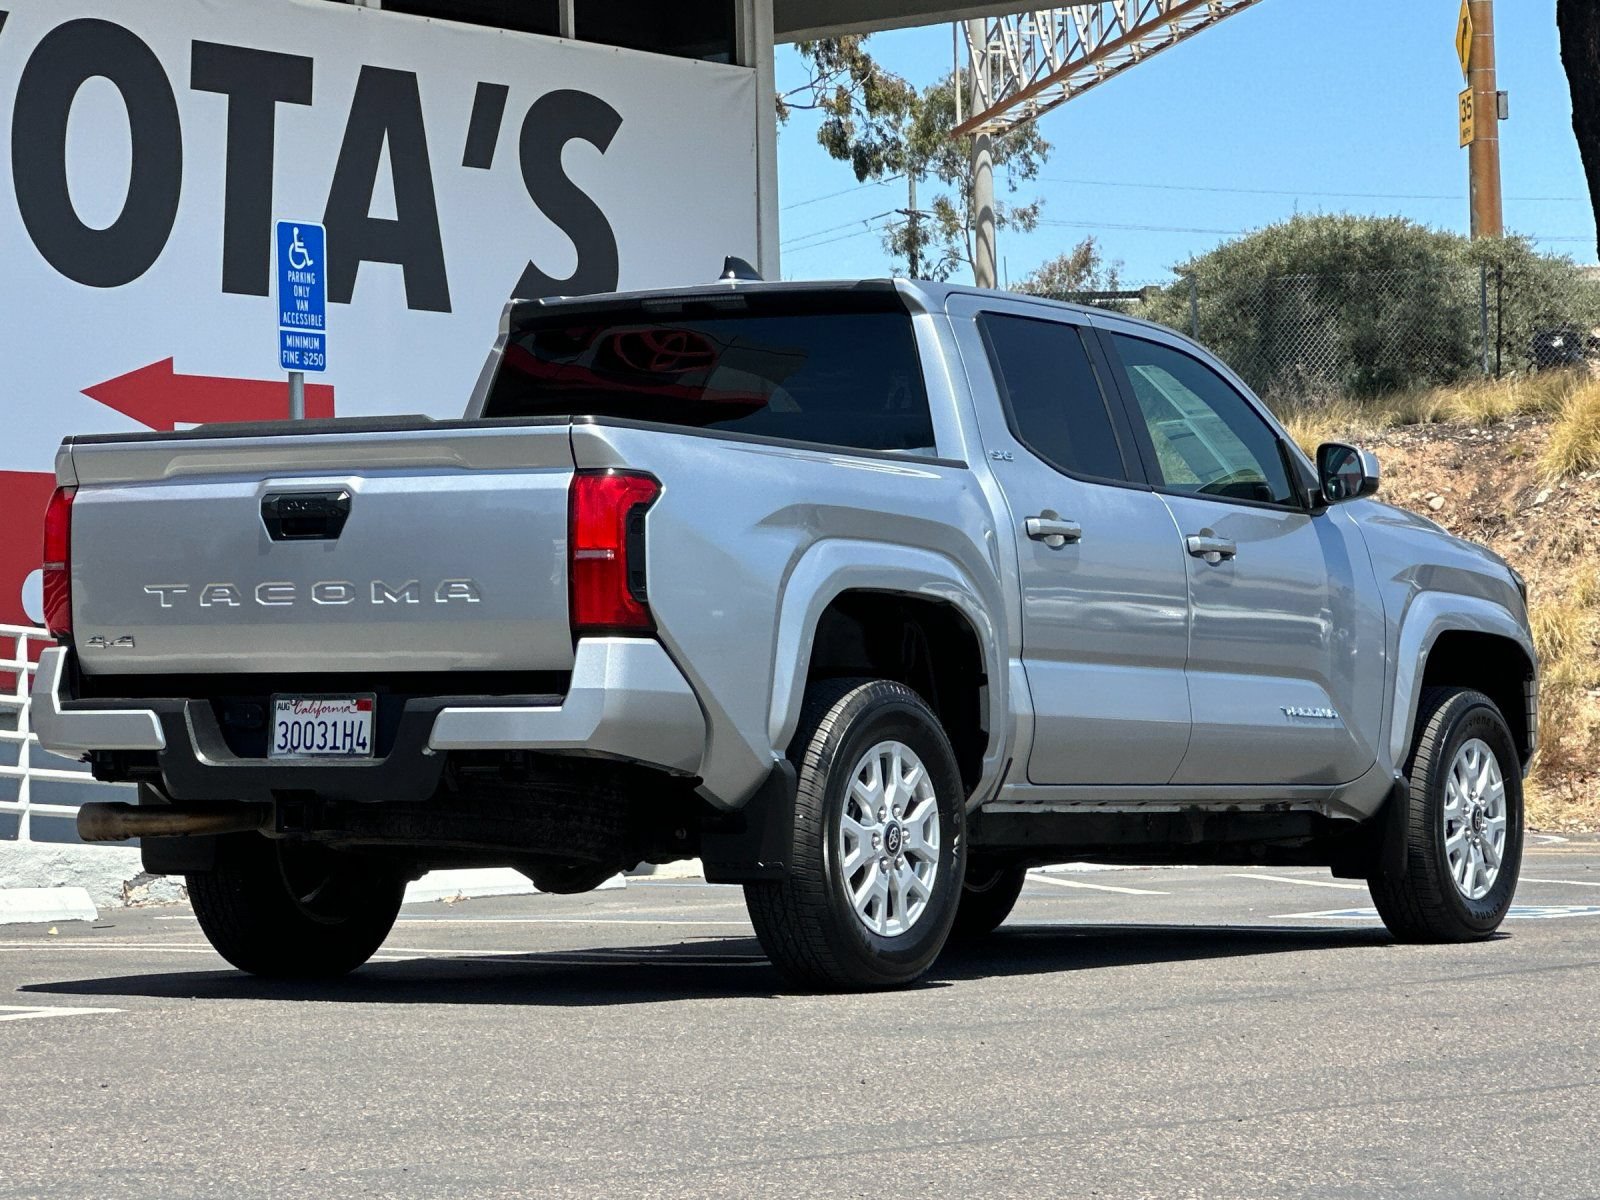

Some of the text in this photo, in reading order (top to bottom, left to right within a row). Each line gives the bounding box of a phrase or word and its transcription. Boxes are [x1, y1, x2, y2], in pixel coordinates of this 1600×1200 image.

[1461, 95, 1473, 123] 35
[0, 10, 624, 314] OTA'S
[287, 270, 316, 285] PARKING
[293, 285, 310, 298] ONLY
[296, 299, 309, 312] VAN
[282, 313, 323, 327] ACCESSIBLE
[286, 334, 320, 350] MINIMUM
[282, 350, 324, 367] FINE $250
[143, 577, 482, 608] TACOMA
[277, 701, 290, 711] AUG
[293, 699, 358, 719] California
[277, 720, 368, 751] 30031H4
